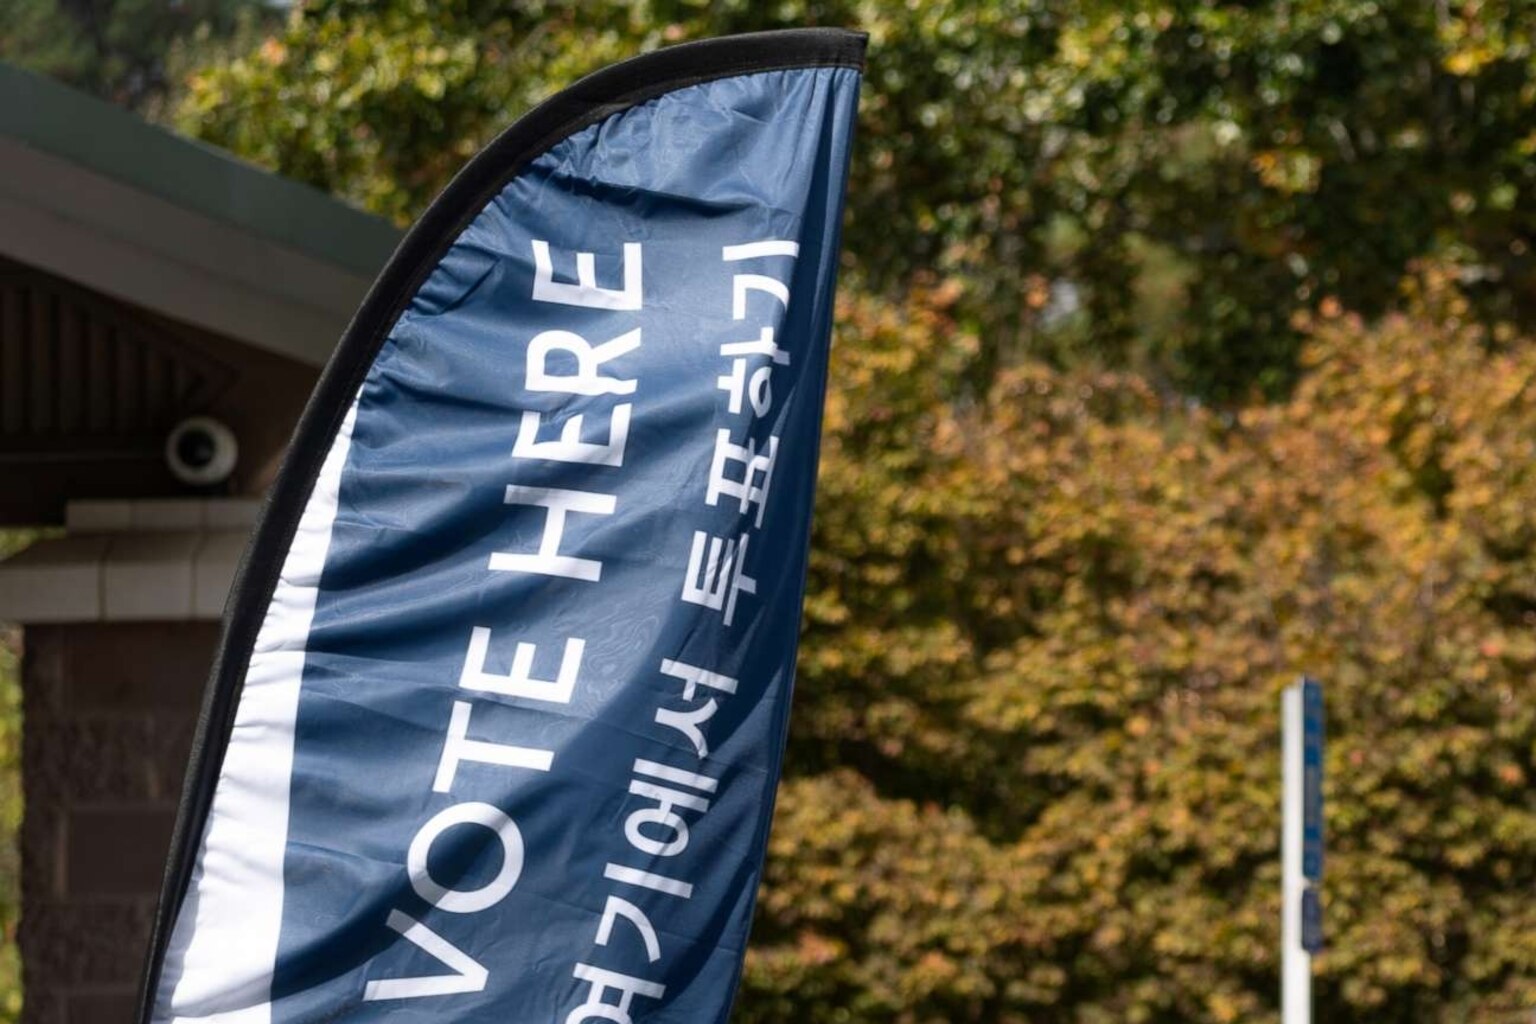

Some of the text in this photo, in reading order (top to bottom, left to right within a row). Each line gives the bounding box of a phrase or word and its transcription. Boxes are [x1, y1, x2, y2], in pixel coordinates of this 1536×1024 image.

[362, 239, 642, 1001] VOTE HERE
[681, 240, 799, 626] 투표하기
